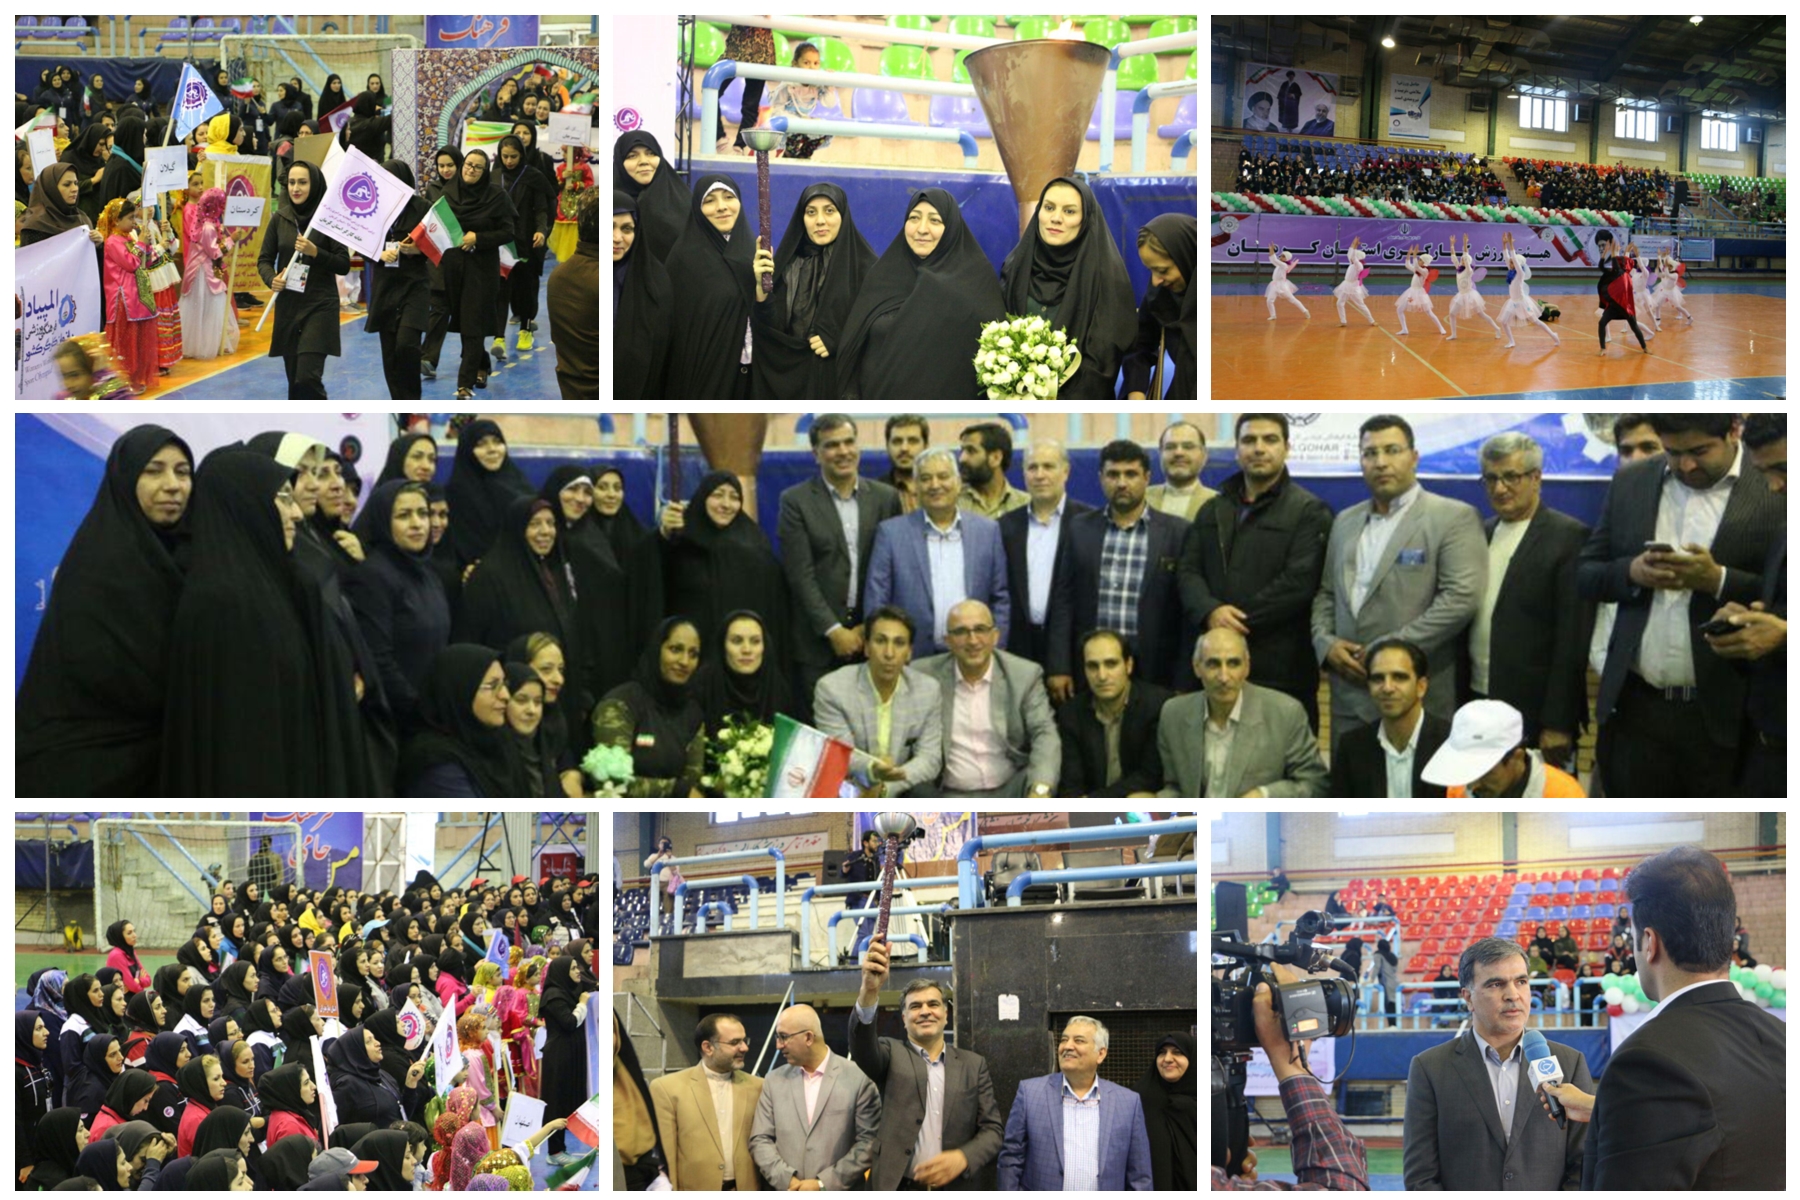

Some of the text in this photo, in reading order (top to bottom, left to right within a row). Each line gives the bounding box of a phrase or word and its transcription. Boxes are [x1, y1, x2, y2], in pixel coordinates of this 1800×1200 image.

[439, 15, 510, 47] فرهنگ
[160, 161, 175, 174] گیلان
[230, 205, 260, 216] کردستان
[1475, 245, 1506, 262] رزش
[26, 288, 59, 321] المپیاد
